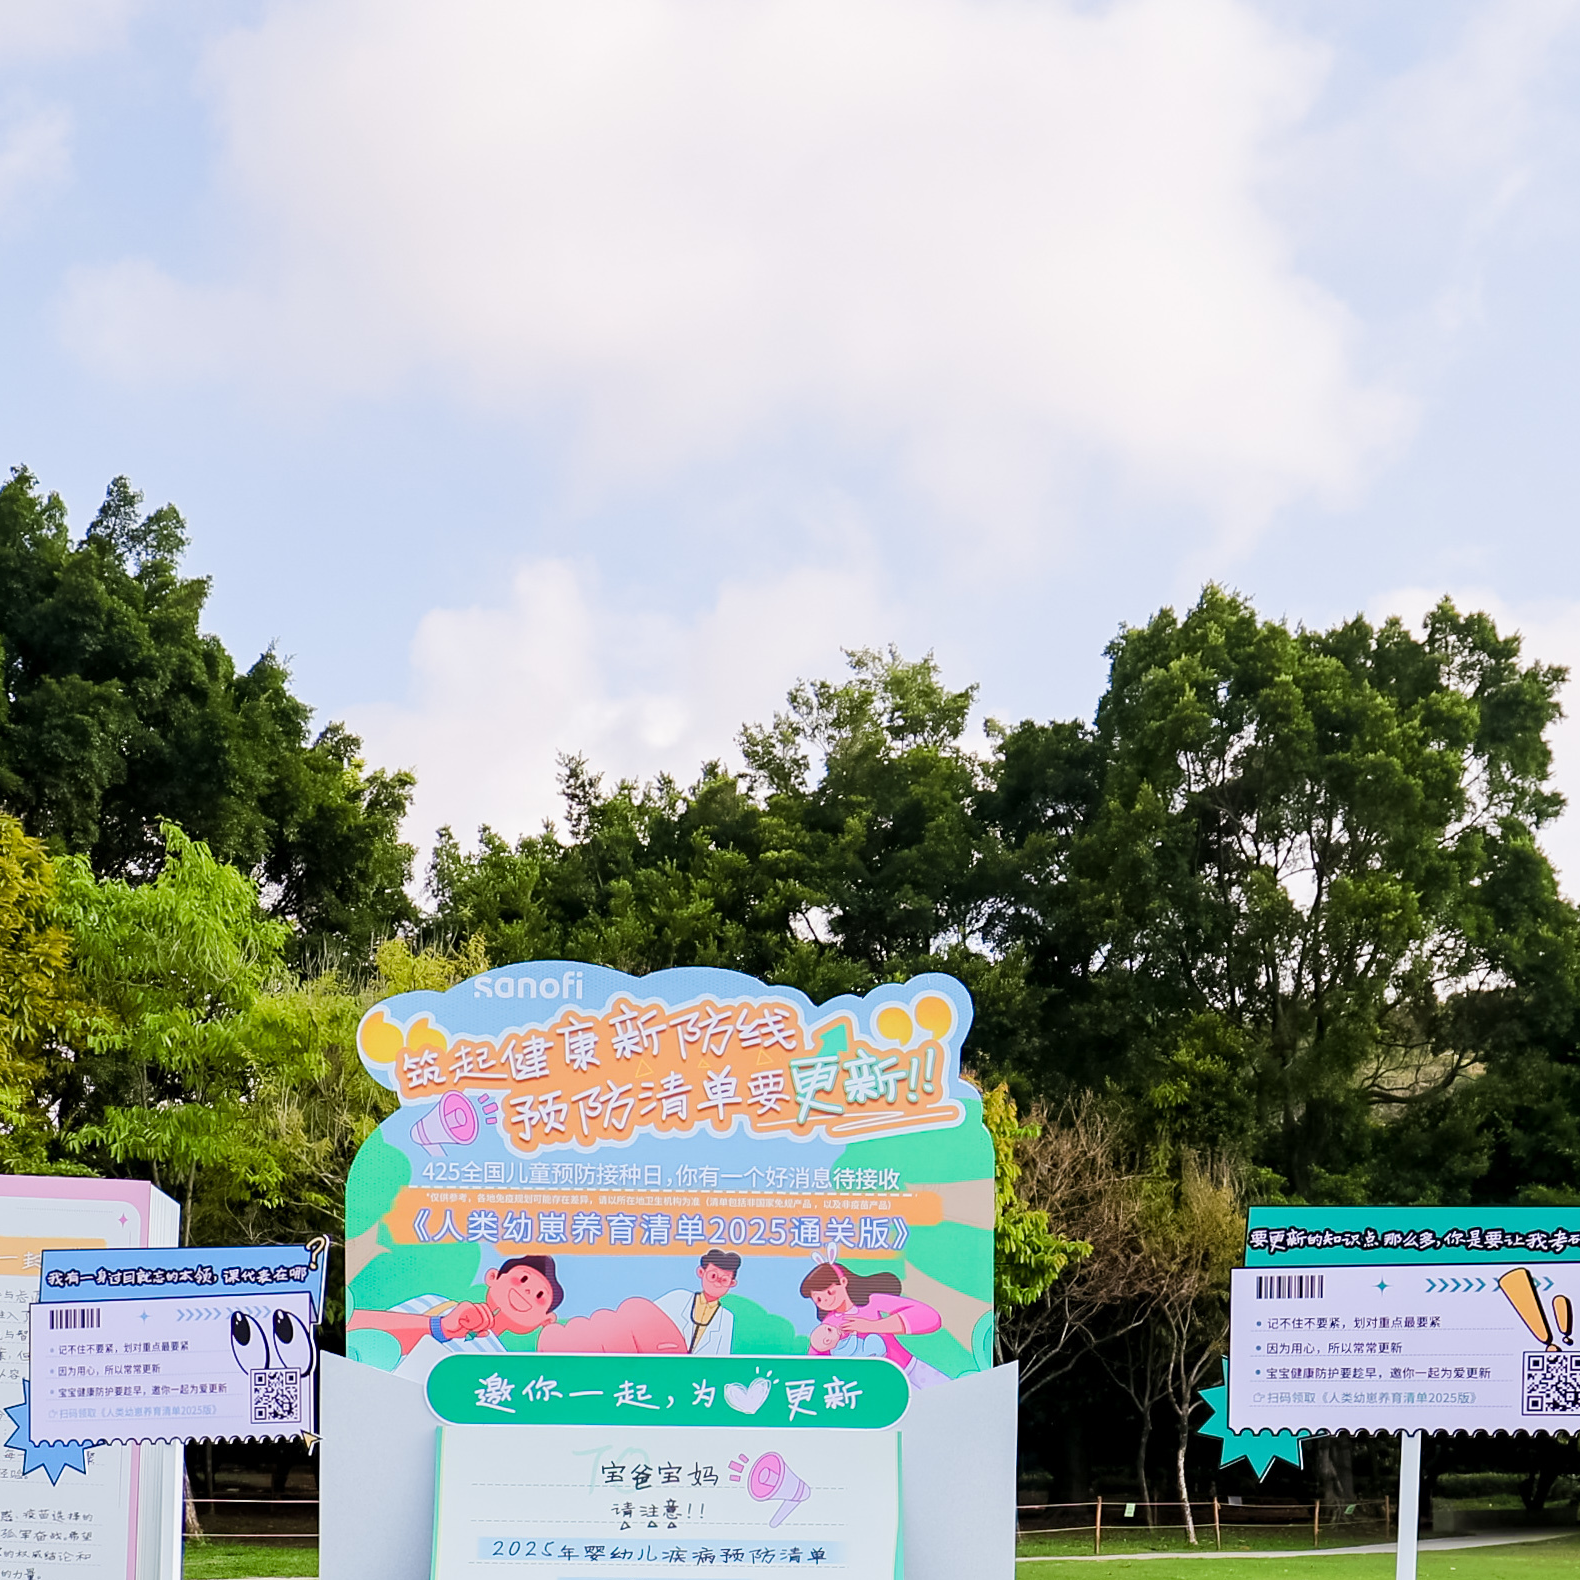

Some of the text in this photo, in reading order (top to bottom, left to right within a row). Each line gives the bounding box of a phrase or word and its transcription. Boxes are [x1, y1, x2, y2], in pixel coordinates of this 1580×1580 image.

[473, 971, 584, 1000] sanofi
[403, 1009, 797, 1089] 筑起健康新防线
[414, 1212, 909, 1249] 《人类幼崽养育清单2025通关版》
[1267, 1316, 1441, 1330] 记不住不要紧，划对重点最要紧
[58, 1341, 189, 1355] 记不住不要紧，划对重点最要紧
[1266, 1341, 1402, 1355] 因为用心，所以常常更新
[58, 1364, 161, 1376] 因为用心，所以常常更新
[1266, 1366, 1491, 1380] 宝宝健康防护要趁早，邀你一起为爱更新
[58, 1383, 227, 1397] 宝宝健康防护要趁早，邀你一起为爱更新
[784, 1377, 864, 1420] 更新
[600, 1461, 719, 1490] 宝爸宝妈
[491, 1540, 827, 1565] 2025年婴幼儿疾病预防清单
